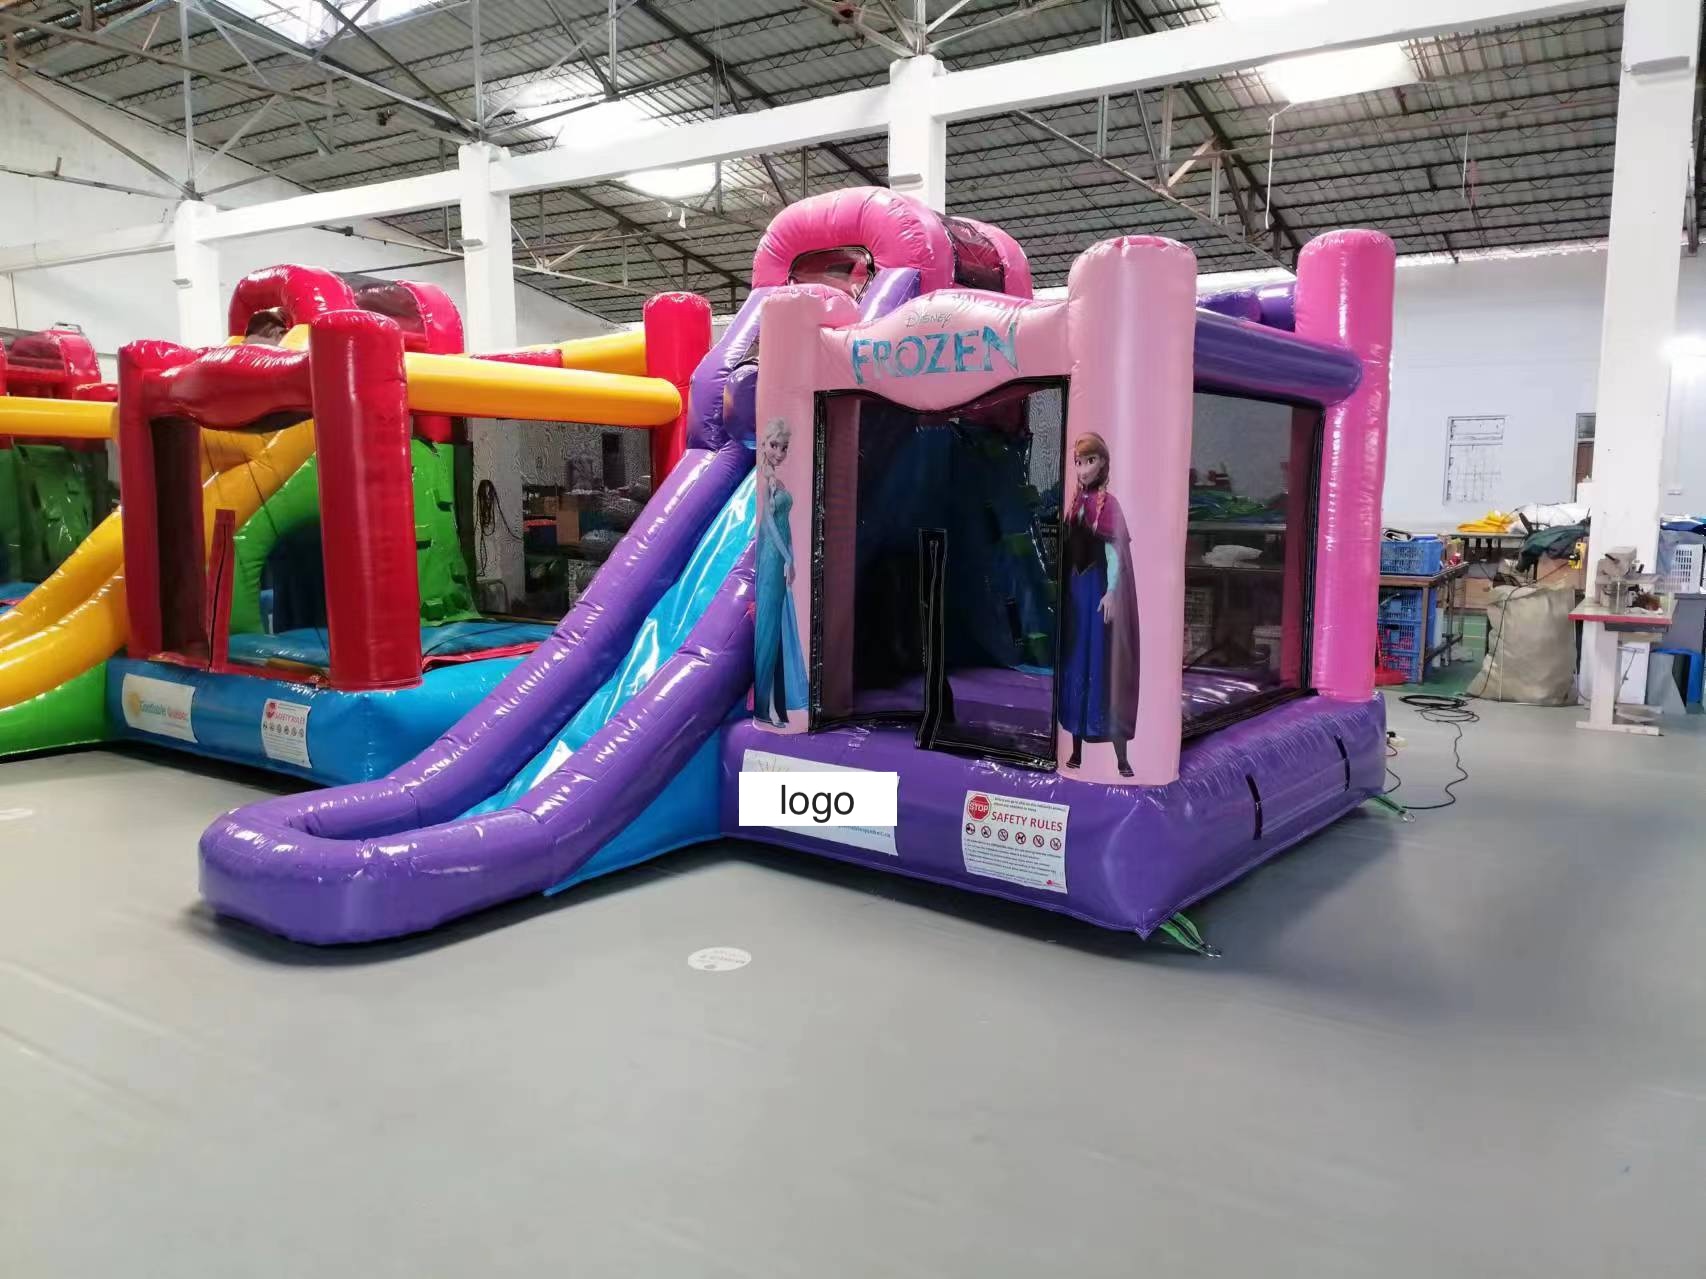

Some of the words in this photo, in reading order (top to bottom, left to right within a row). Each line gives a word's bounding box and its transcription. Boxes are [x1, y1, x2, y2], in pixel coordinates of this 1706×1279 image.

[852, 321, 1021, 385] FROZEN
[969, 802, 990, 812] STOP
[991, 811, 1028, 825] SAFETY
[1030, 818, 1063, 832] RULES
